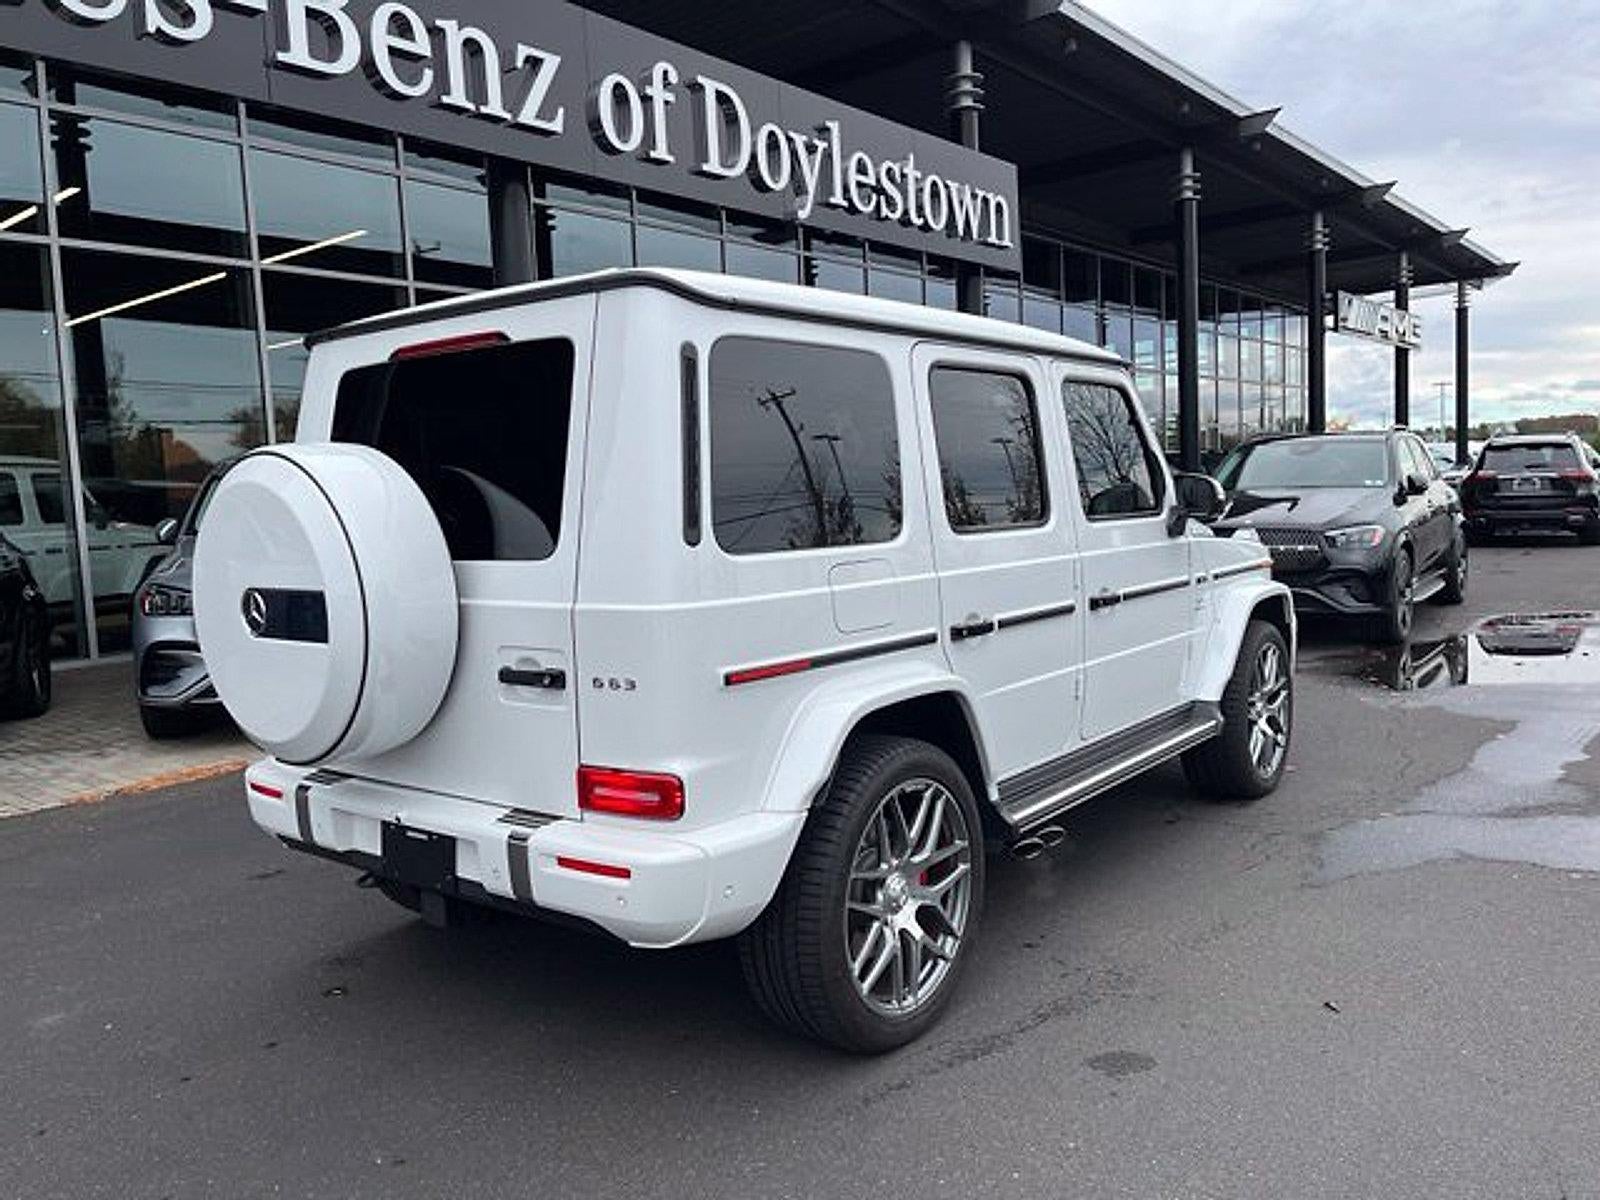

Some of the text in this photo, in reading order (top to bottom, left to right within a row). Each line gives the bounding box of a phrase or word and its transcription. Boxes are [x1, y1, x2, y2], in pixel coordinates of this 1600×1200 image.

[57, 0, 1014, 249] -Benz of Doylestown
